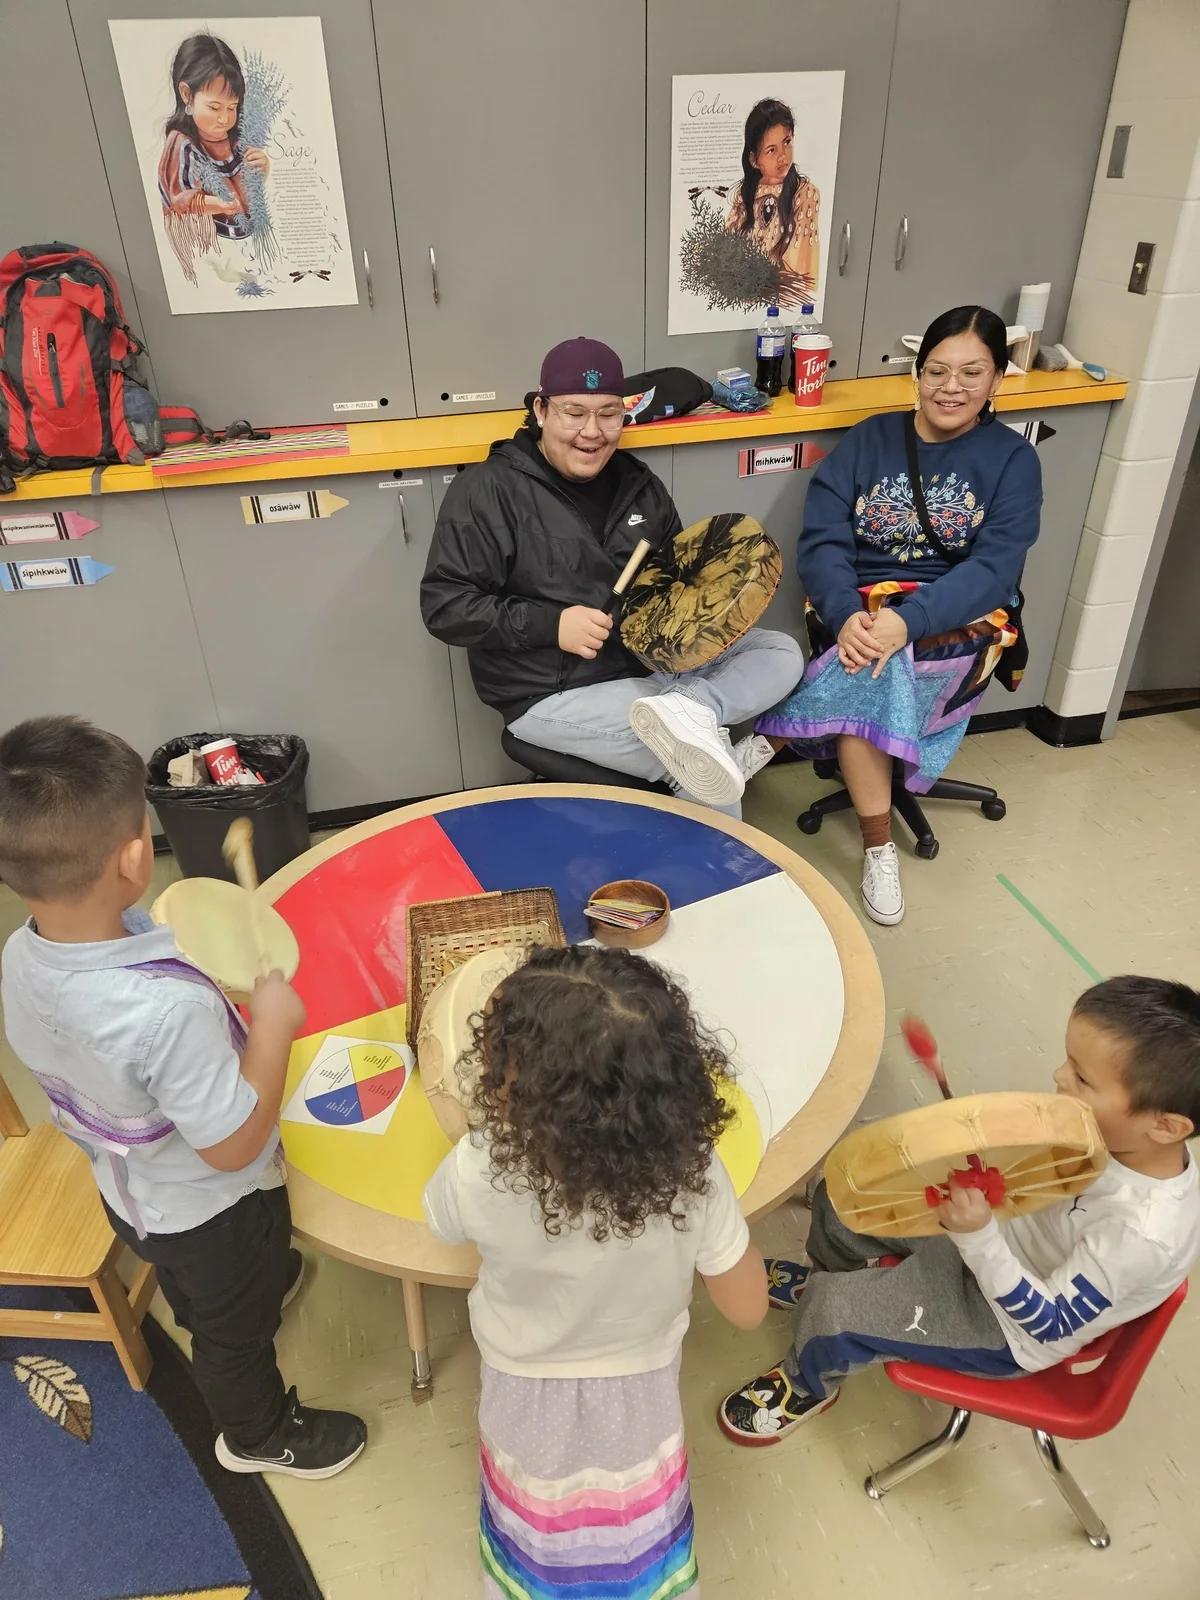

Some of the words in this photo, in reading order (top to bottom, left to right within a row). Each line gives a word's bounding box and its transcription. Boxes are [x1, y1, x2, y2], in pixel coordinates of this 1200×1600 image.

[687, 90, 736, 118] Cedar
[266, 132, 312, 167] Sage
[802, 355, 828, 376] Tim
[211, 755, 238, 776] Tim
